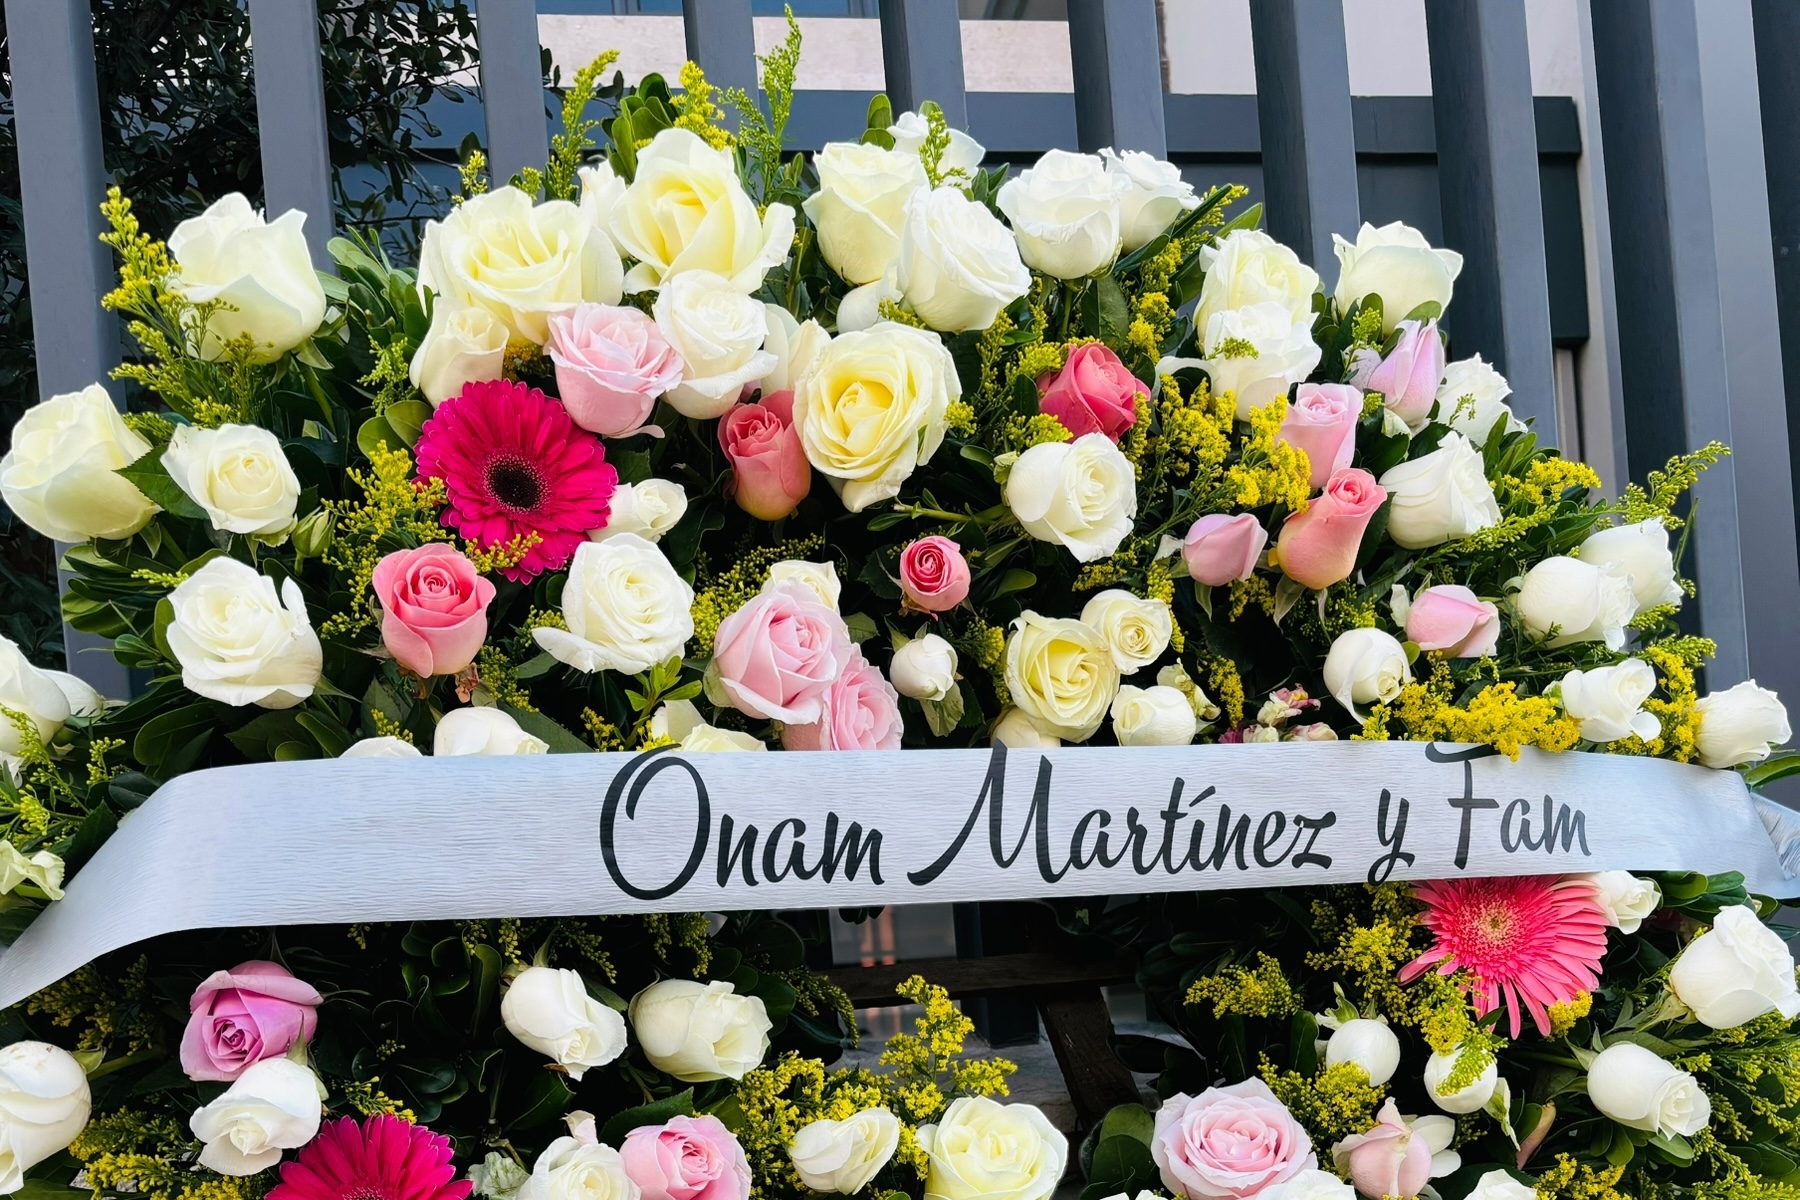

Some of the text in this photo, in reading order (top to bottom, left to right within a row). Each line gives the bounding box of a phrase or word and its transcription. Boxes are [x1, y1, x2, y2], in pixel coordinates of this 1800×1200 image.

[600, 739, 1593, 900] Onam Martínez y Fam
